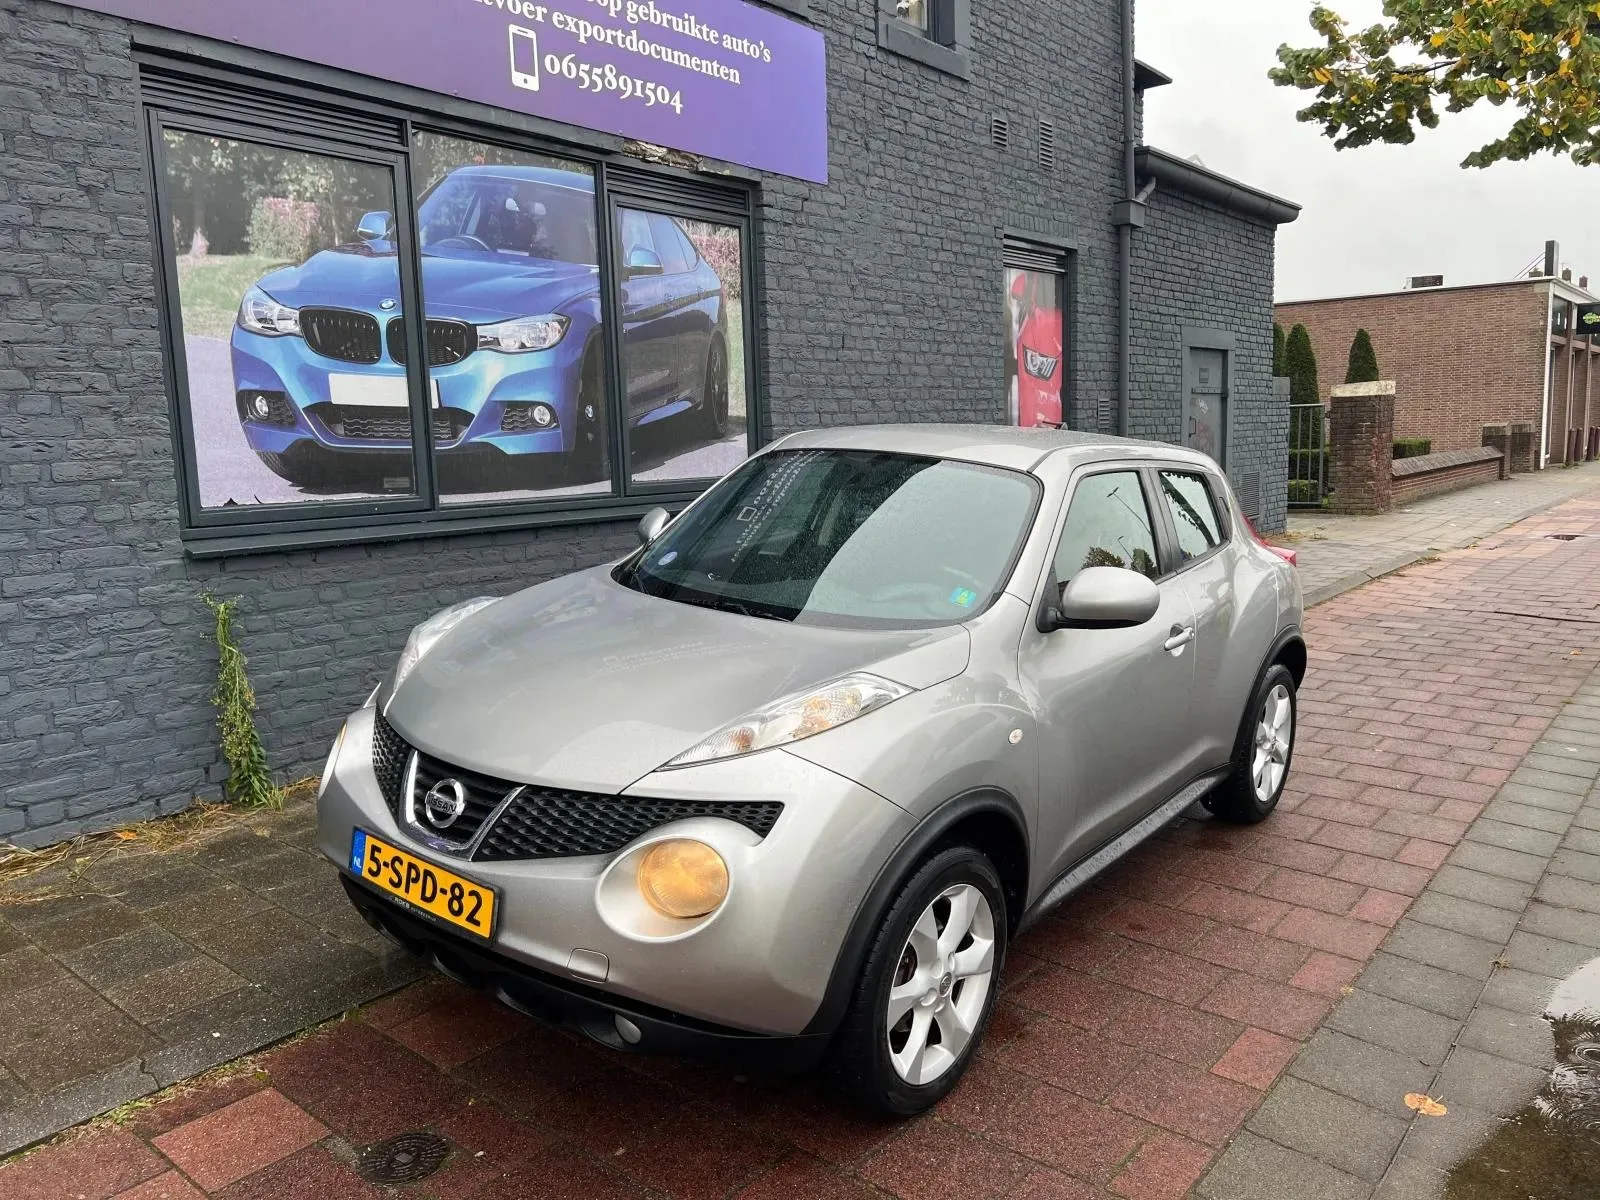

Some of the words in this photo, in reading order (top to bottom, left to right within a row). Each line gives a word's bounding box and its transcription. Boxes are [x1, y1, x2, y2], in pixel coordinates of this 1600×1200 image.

[552, 11, 741, 84] exportdocumenten
[626, 0, 719, 44] gebruikte
[722, 34, 771, 62] auto's
[544, 53, 684, 115] 0655891504
[367, 843, 483, 927] 5-SPD-82
